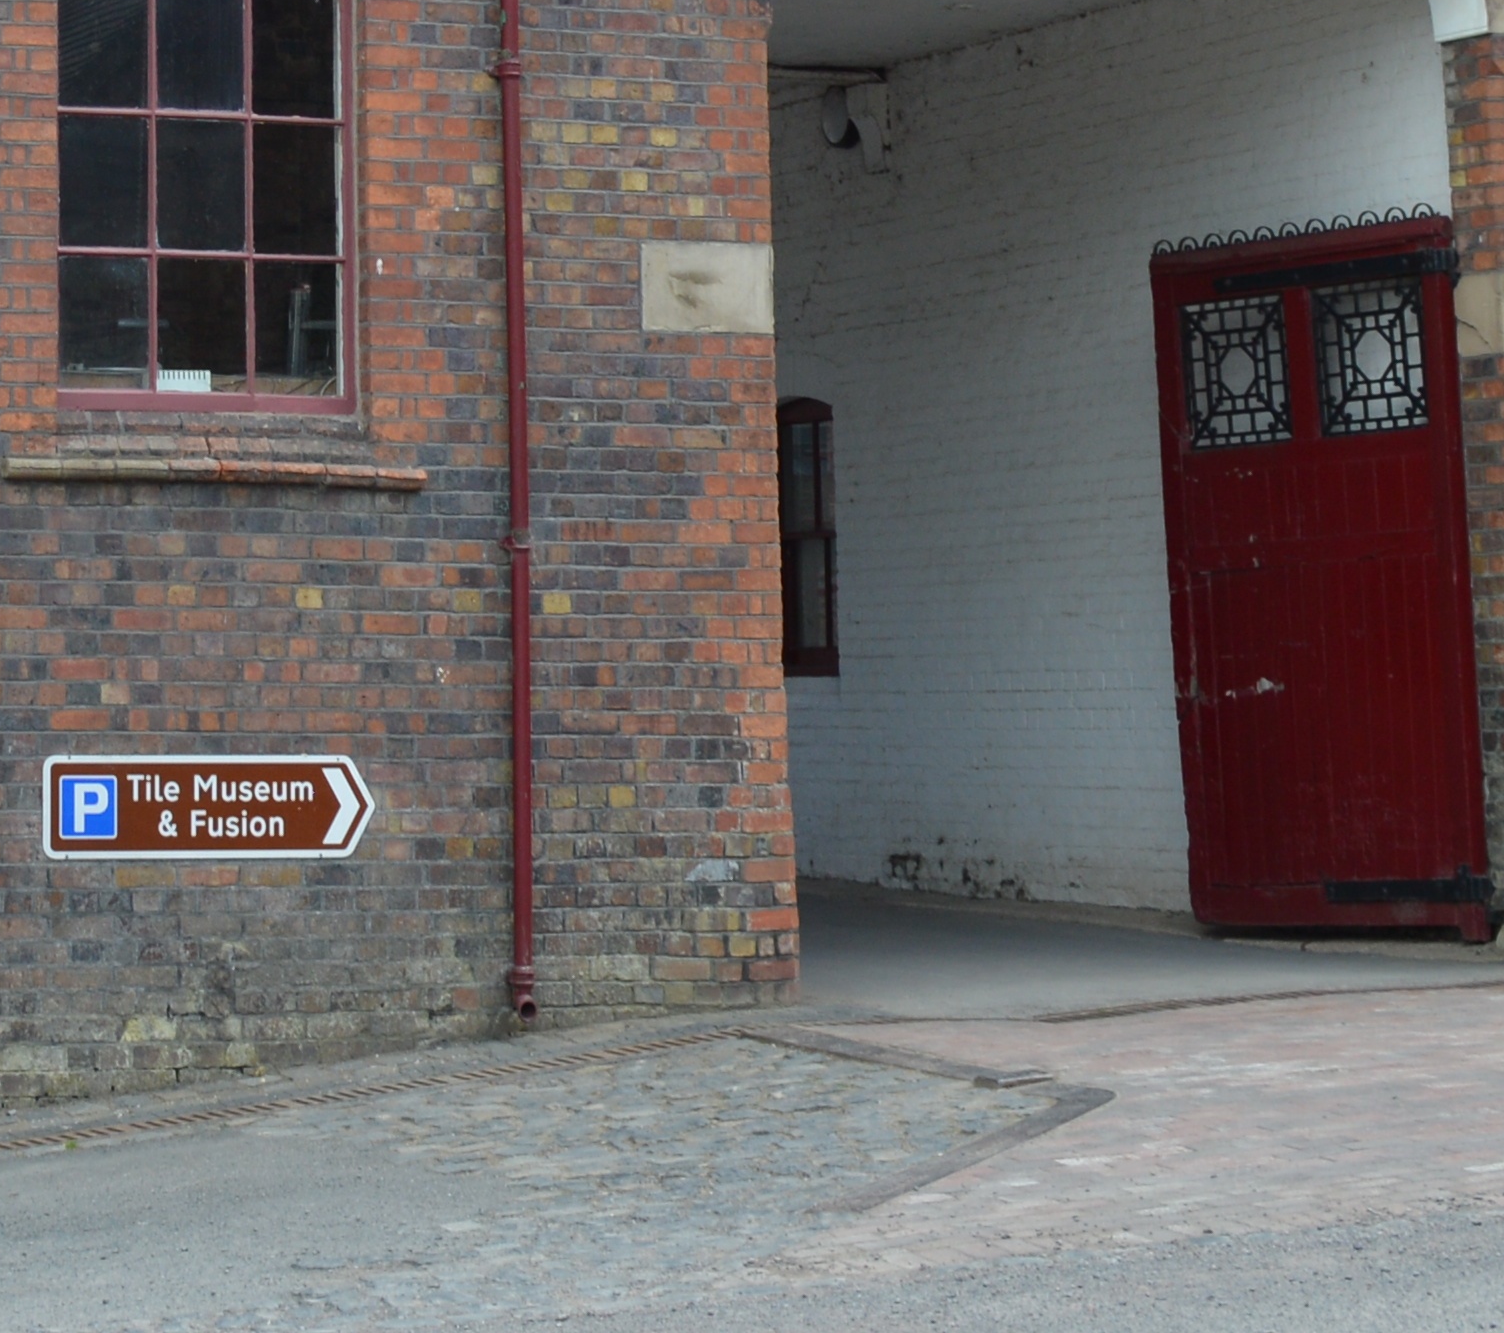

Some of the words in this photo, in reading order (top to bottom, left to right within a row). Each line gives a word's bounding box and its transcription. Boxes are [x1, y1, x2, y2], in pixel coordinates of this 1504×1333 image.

[127, 774, 180, 802] Tile
[193, 774, 314, 802] Museum
[73, 783, 109, 833] P
[158, 810, 178, 837] &
[191, 810, 285, 837] Fusion
